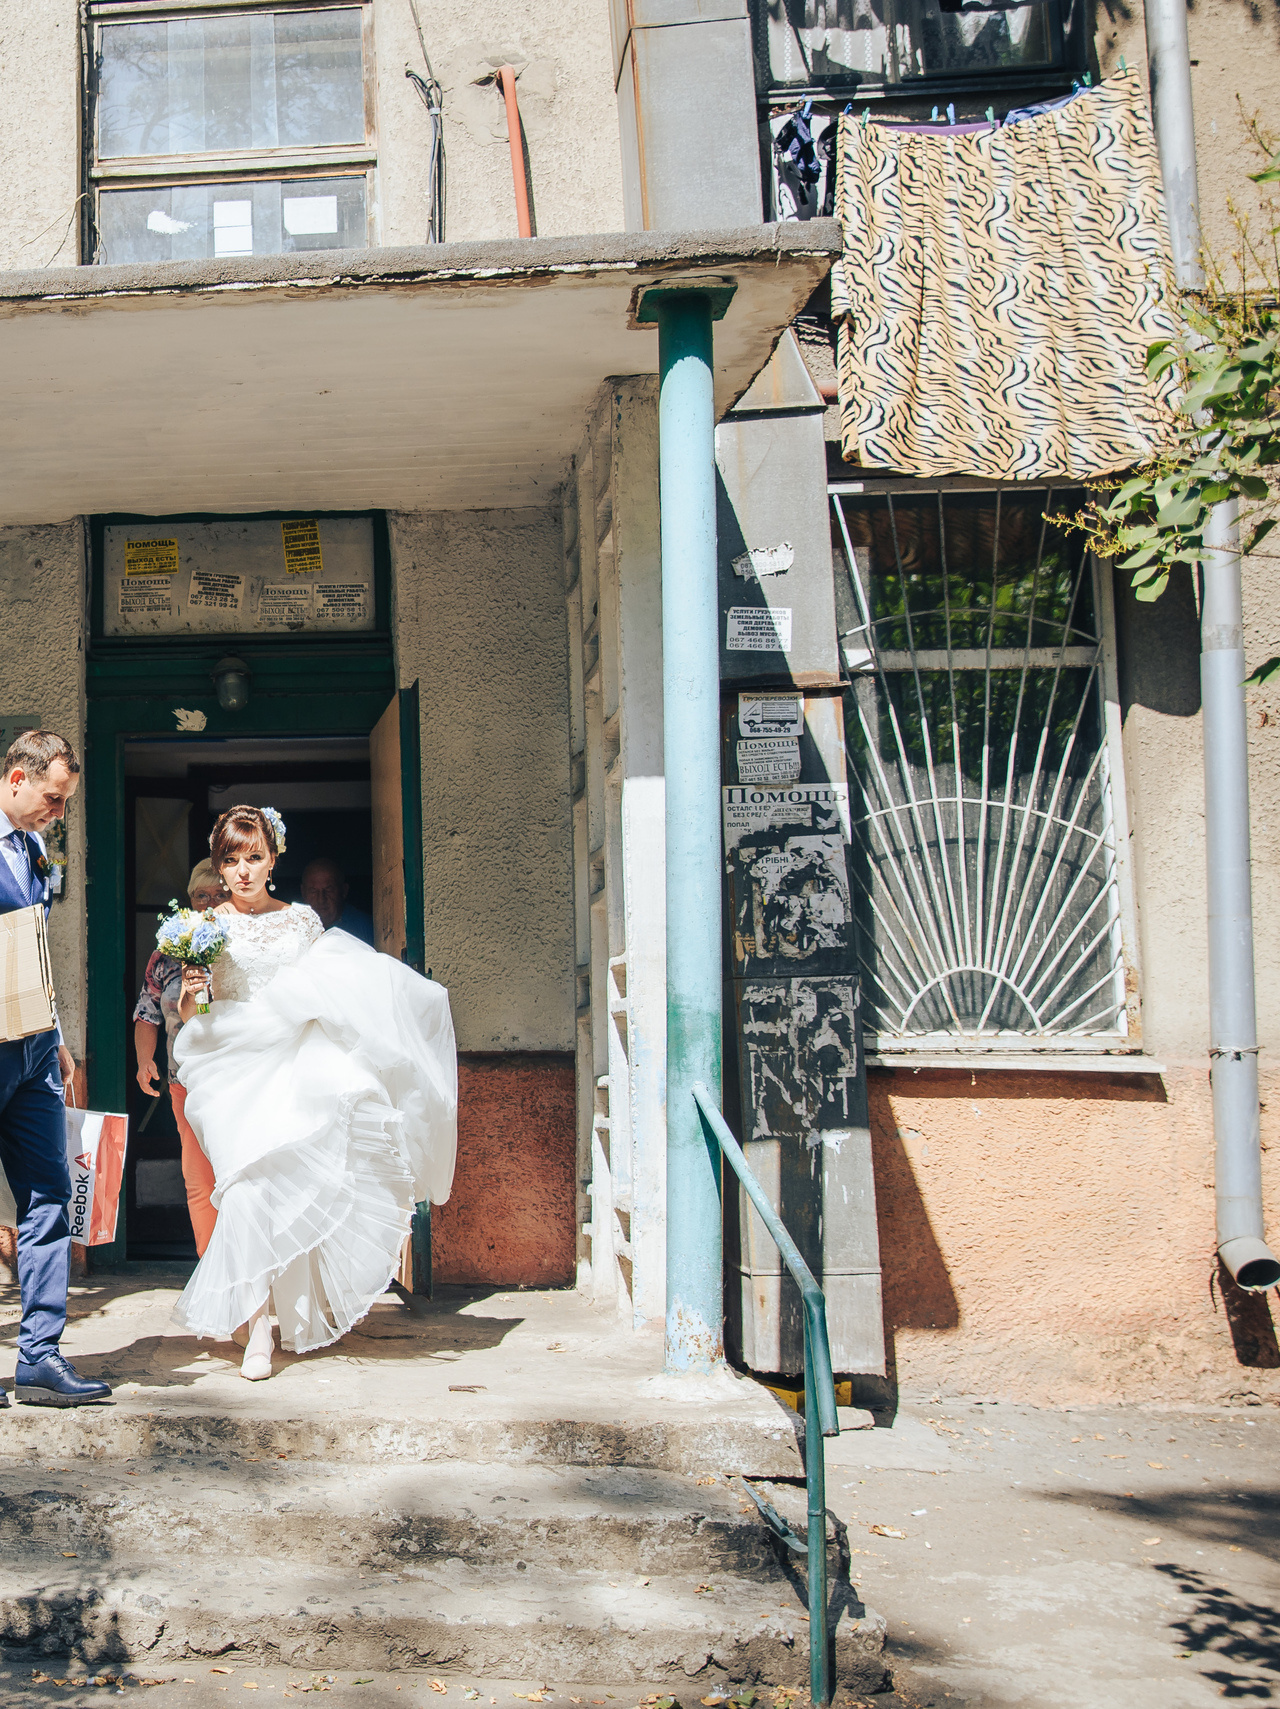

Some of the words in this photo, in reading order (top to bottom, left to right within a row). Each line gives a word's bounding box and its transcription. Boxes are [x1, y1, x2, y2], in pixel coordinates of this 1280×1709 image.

[127, 540, 175, 549] ПОМОЩЬ
[121, 597, 145, 605] ВЫХОД
[737, 740, 798, 750] Помощь
[739, 764, 770, 774] ВЫХОД
[773, 762, 800, 771] ЕСТЬ!!!
[726, 787, 847, 804] Помощь
[70, 1173, 90, 1238] Reebok
